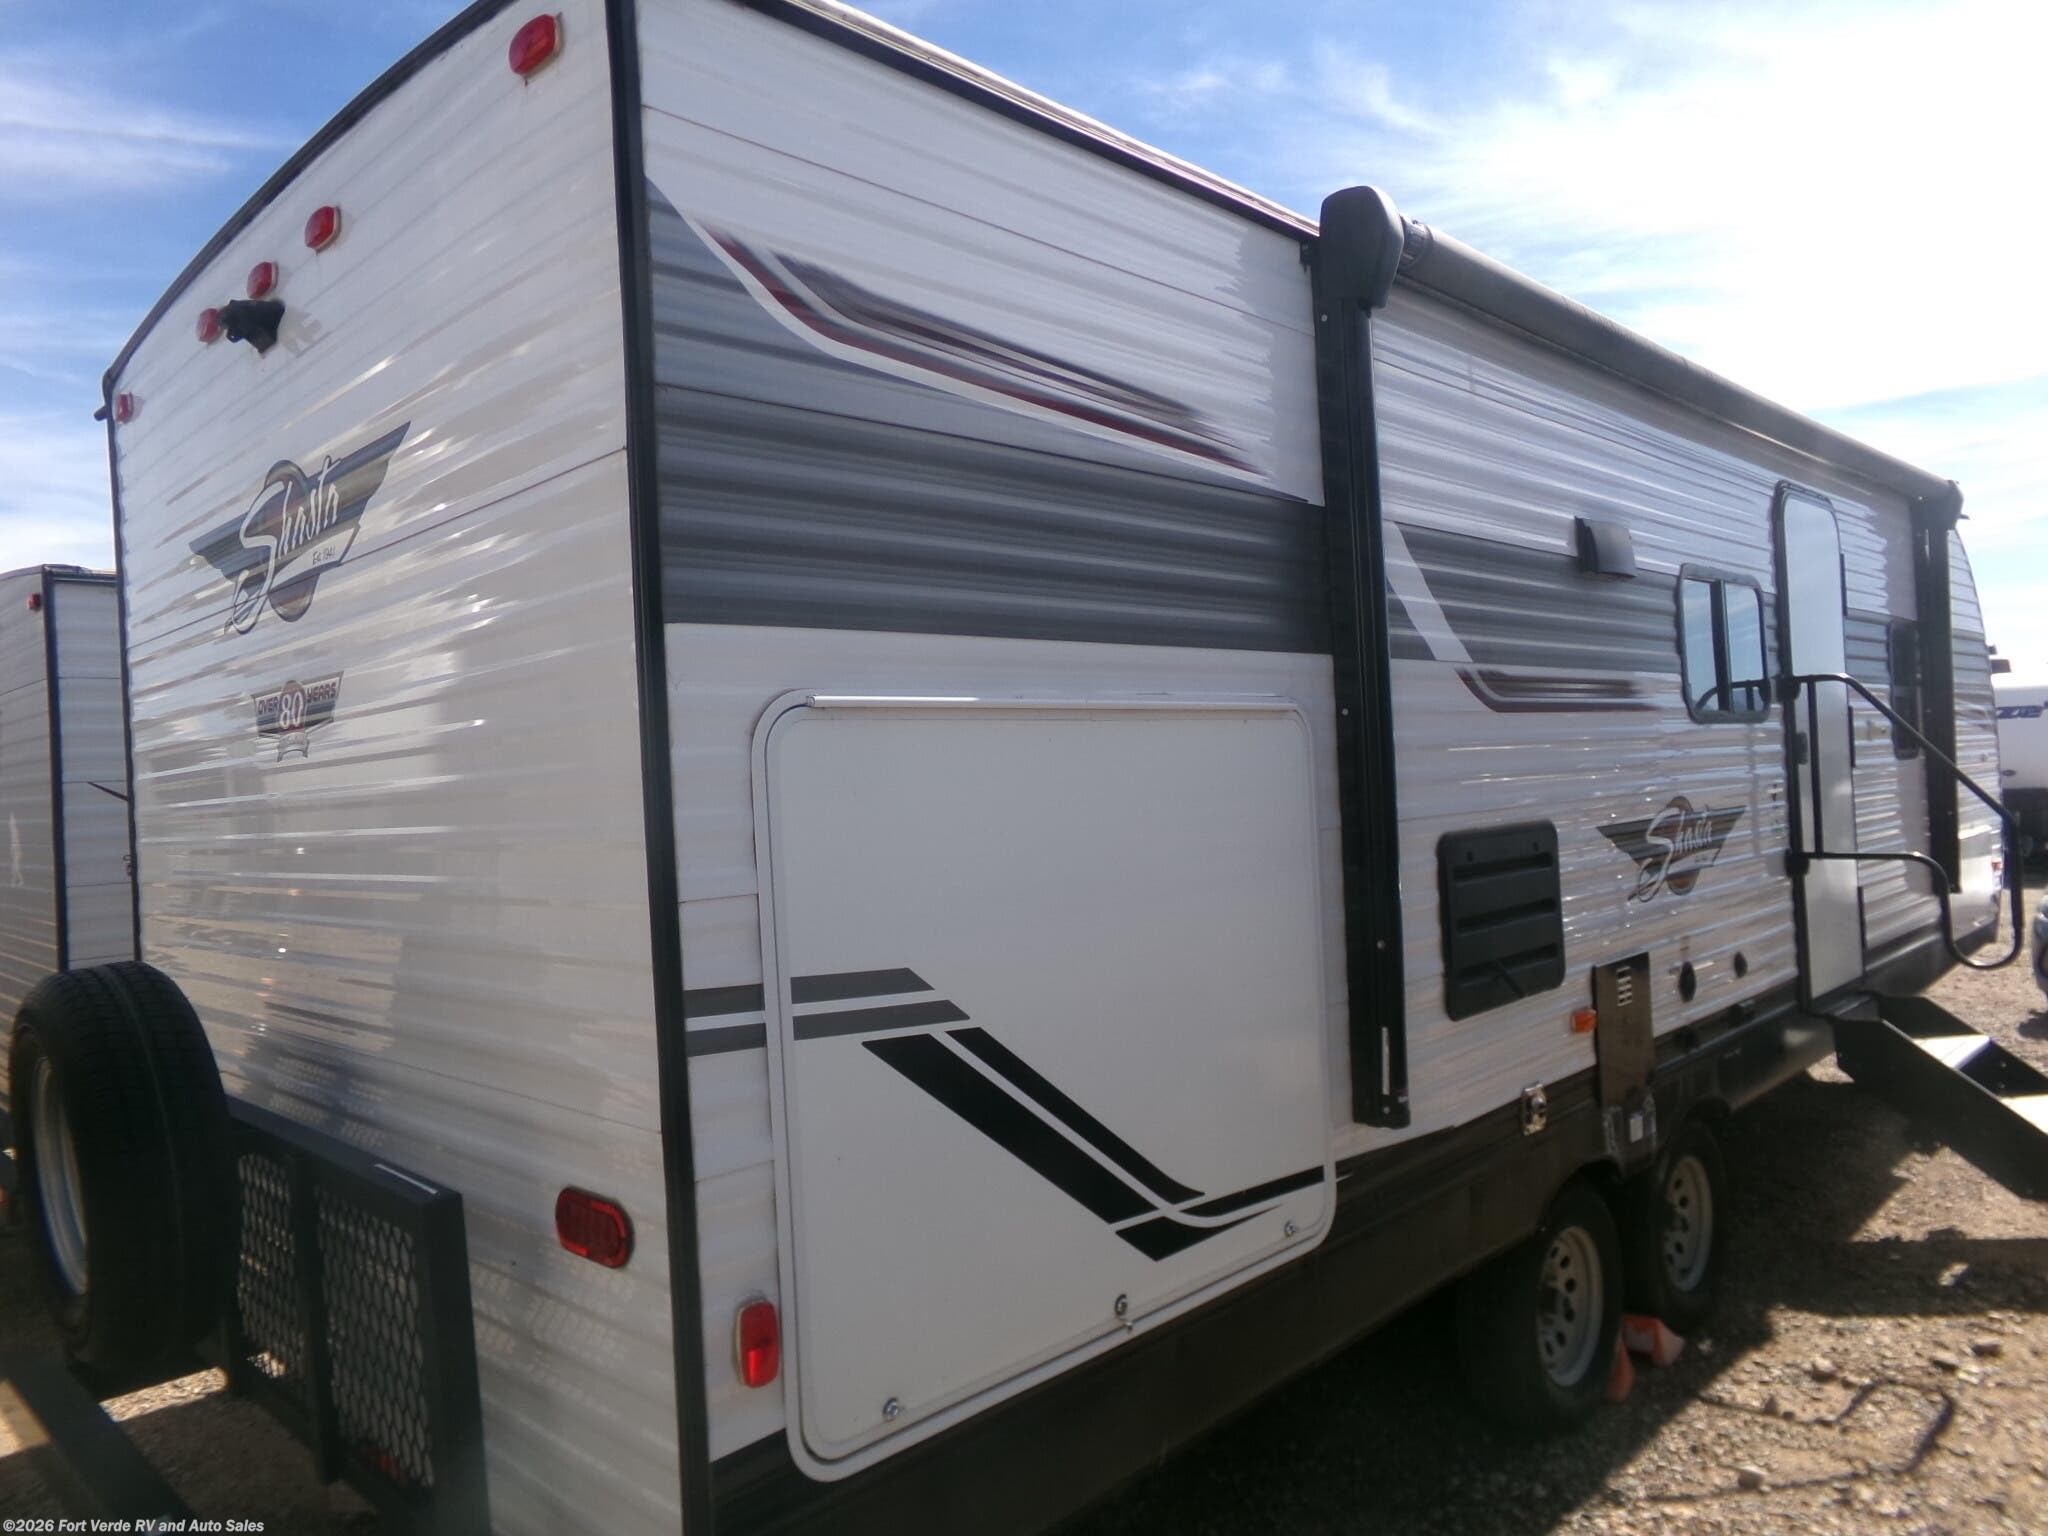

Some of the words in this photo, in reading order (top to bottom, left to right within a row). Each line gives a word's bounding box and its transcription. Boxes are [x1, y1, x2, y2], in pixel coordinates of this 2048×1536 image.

[225, 455, 342, 635] Shasta
[257, 696, 279, 715] OVER
[280, 691, 304, 730] 80
[305, 682, 337, 702] YEARS
[1627, 804, 1713, 903] Shasta
